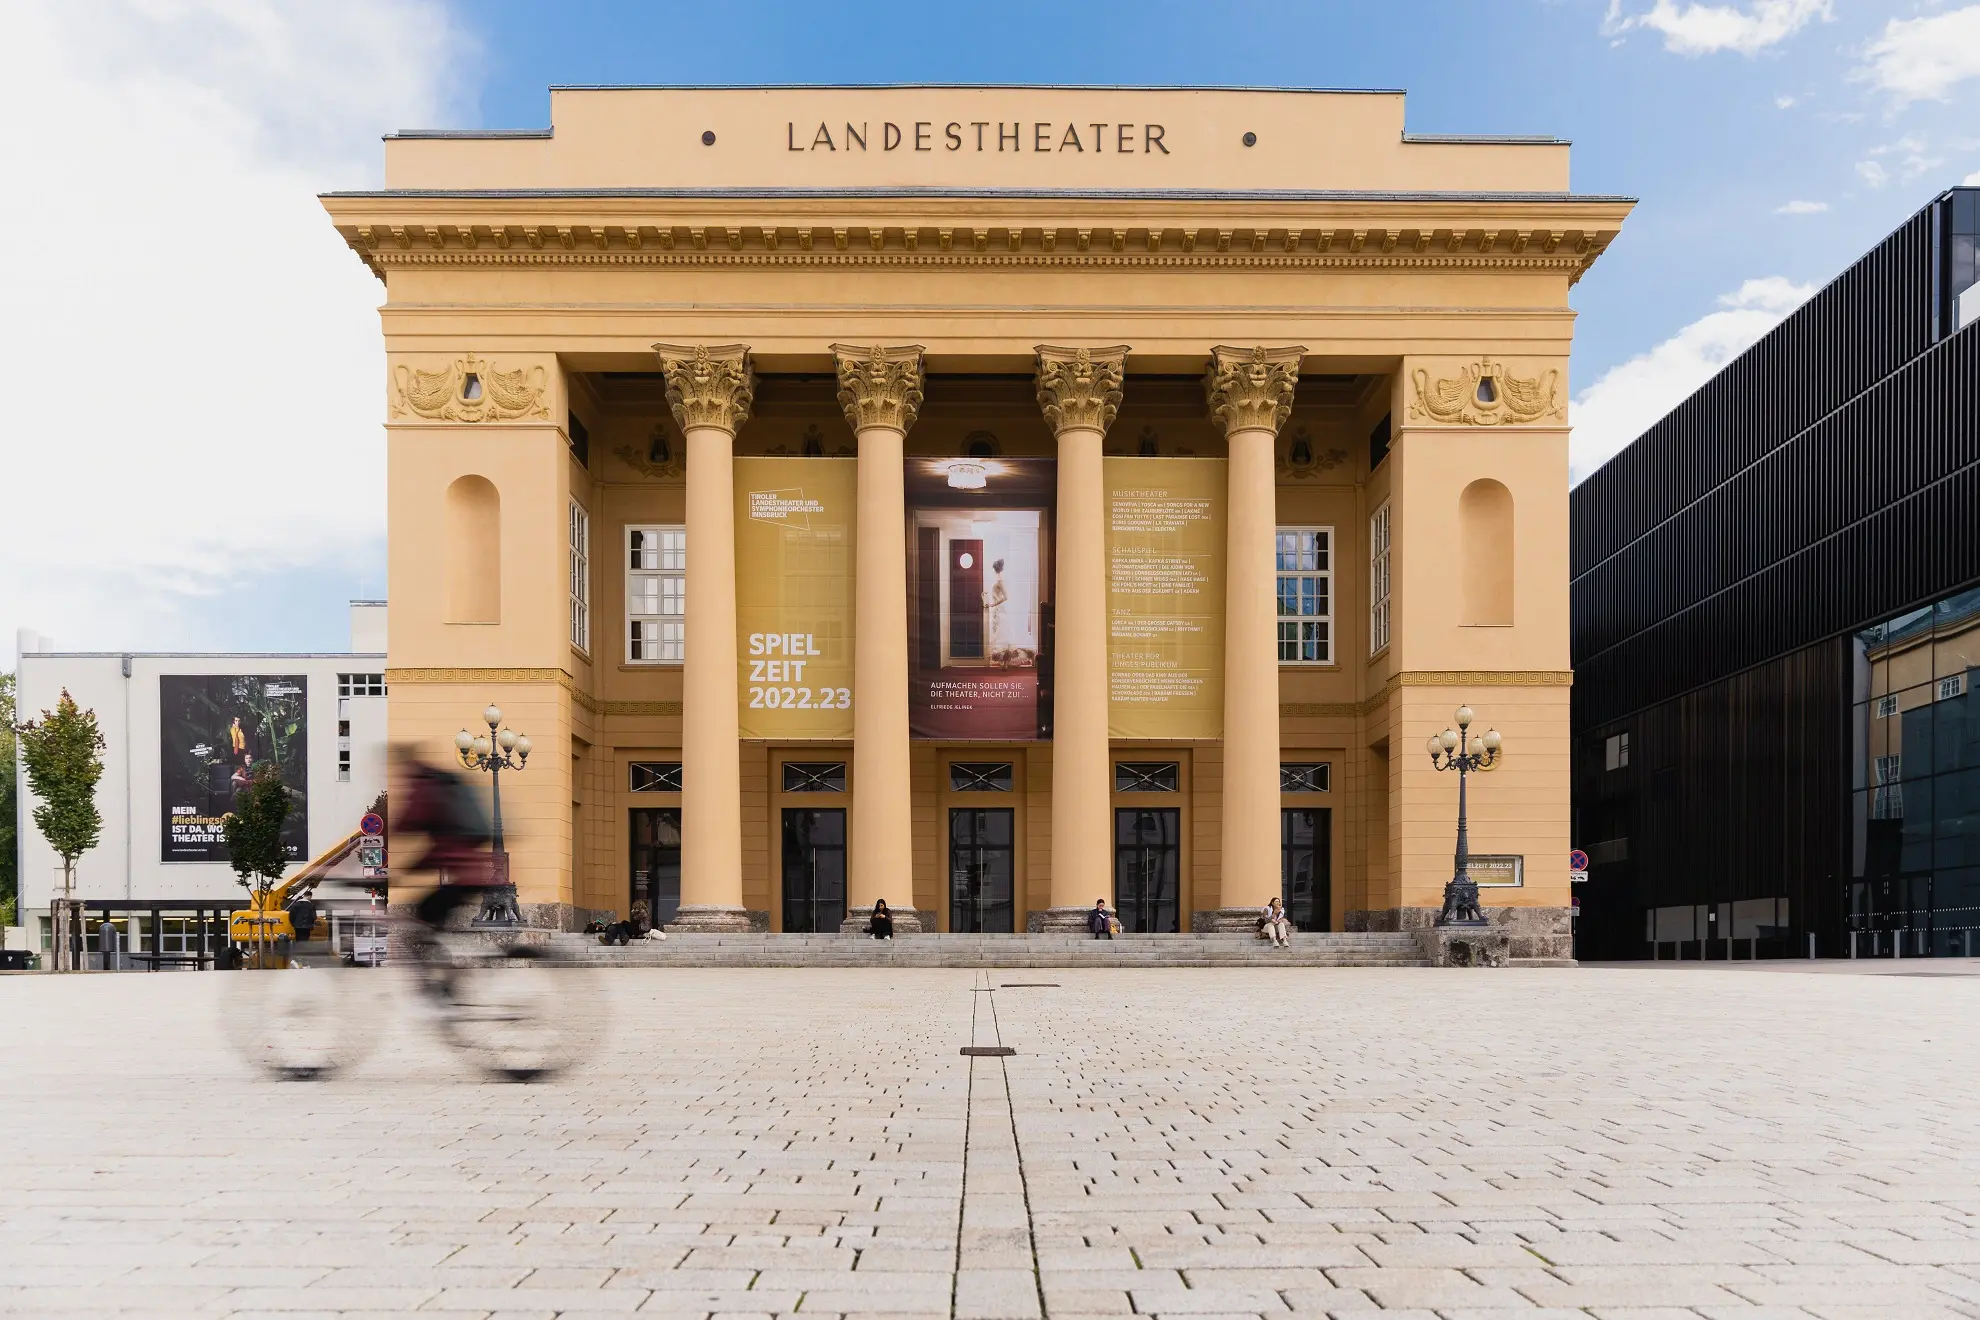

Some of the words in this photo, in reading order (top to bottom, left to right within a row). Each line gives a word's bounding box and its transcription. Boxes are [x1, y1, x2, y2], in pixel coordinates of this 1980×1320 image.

[788, 122, 1170, 154] LANDESTHEATER
[749, 633, 820, 656] SPIEL
[749, 660, 807, 682] ZEIT
[749, 687, 851, 709] 2022.23
[172, 815, 227, 825] #lieblingsp
[172, 825, 187, 833] IST
[189, 825, 205, 834] DA,
[207, 825, 223, 833] WO
[172, 834, 214, 842] THEATER
